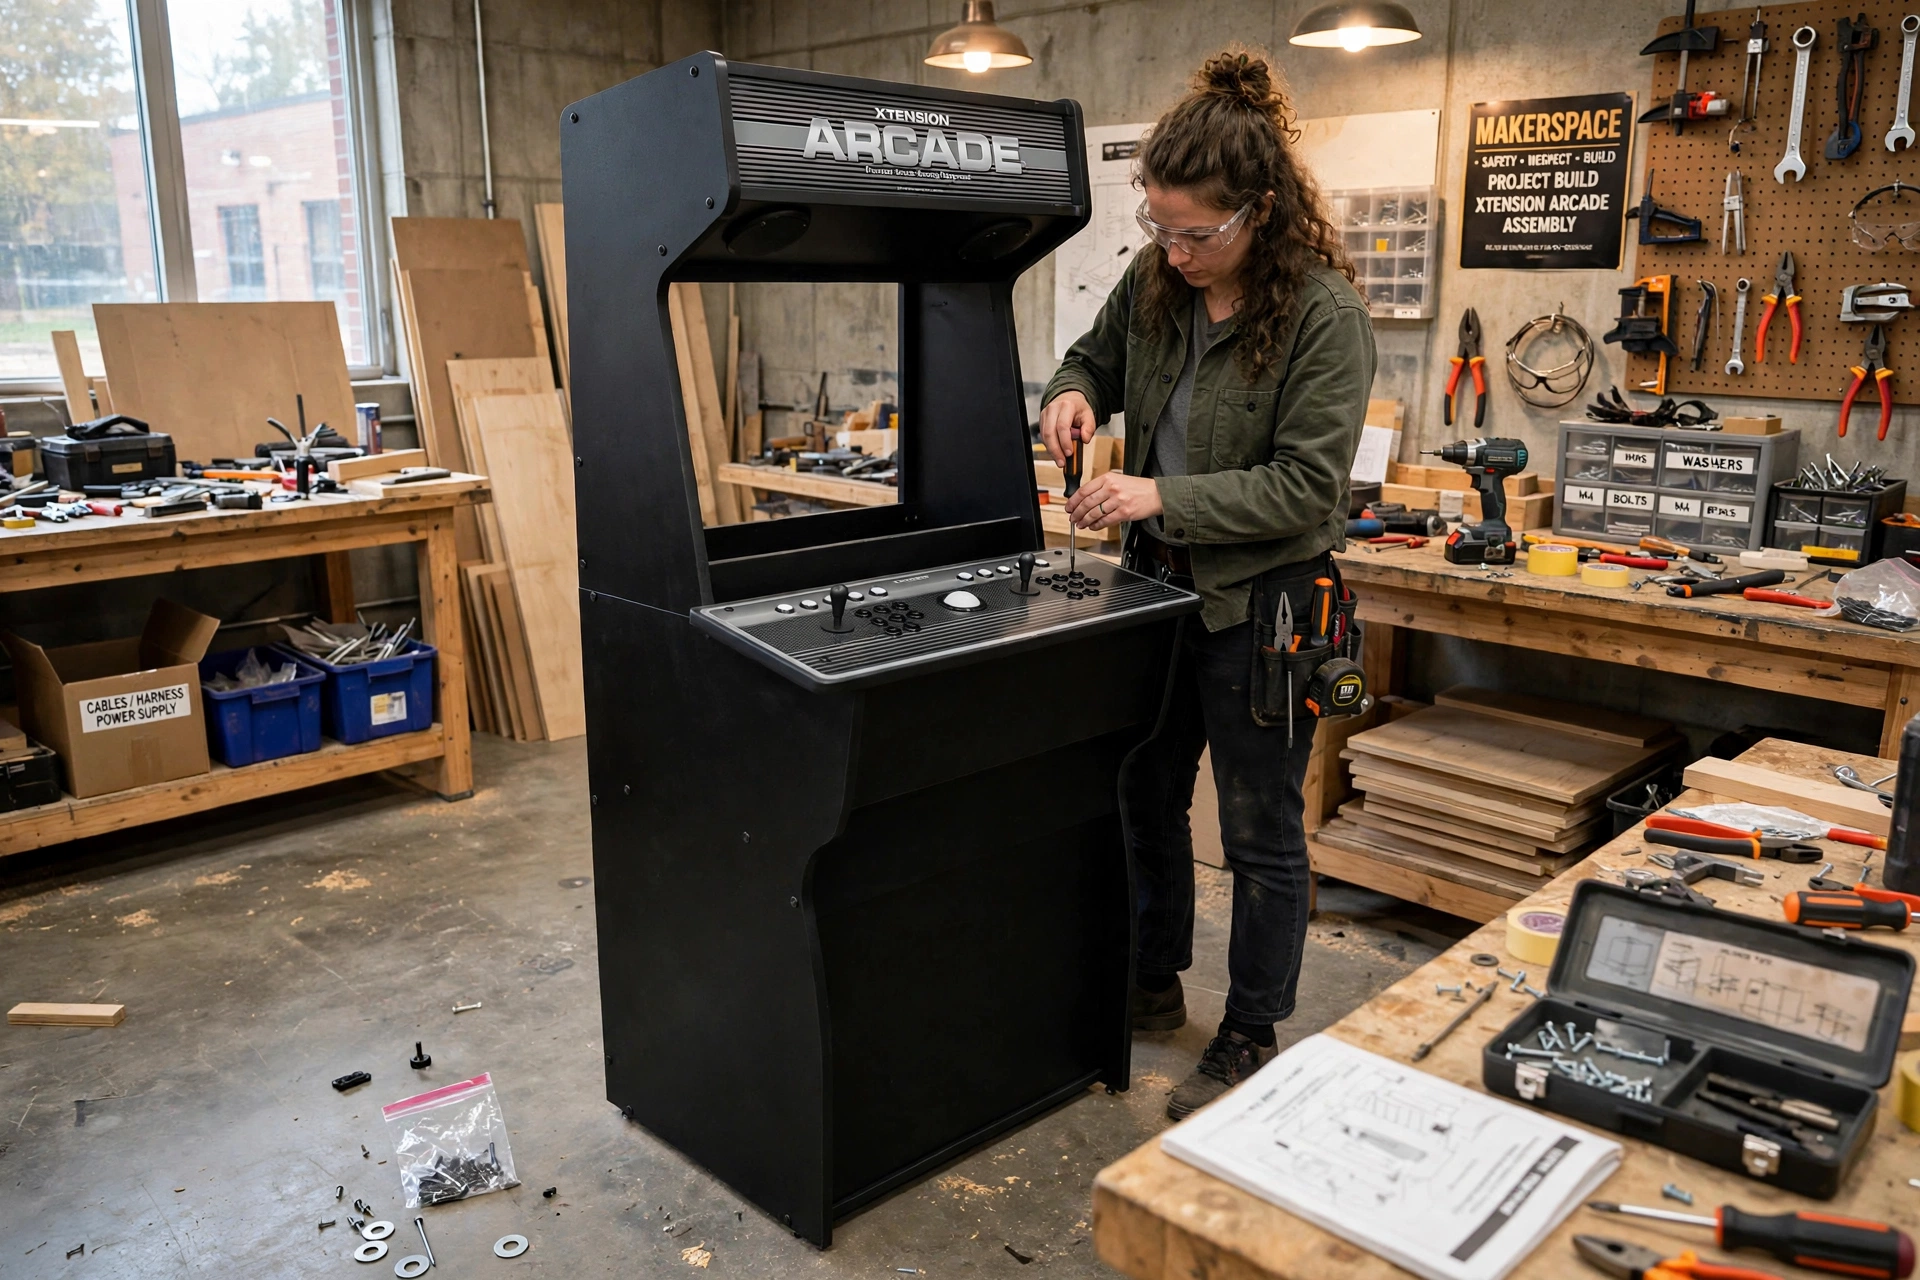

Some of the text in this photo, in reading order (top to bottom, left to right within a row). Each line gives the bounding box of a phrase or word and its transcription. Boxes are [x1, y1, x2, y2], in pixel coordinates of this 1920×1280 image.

[874, 107, 950, 126] XTENSION
[1475, 108, 1623, 145] MAKERSPACE
[802, 117, 1024, 175] ARCADE
[1583, 150, 1616, 164] BUILD
[1487, 170, 1599, 191] PROJECT BUILD
[1475, 193, 1611, 214] XTENSION ARCADE
[1502, 216, 1578, 234] ASSEMBLY
[1613, 493, 1648, 506] BOLTS
[86, 696, 128, 714] CABLES
[136, 687, 184, 706] HARNESS
[96, 702, 177, 727] POWER SUPPLY
